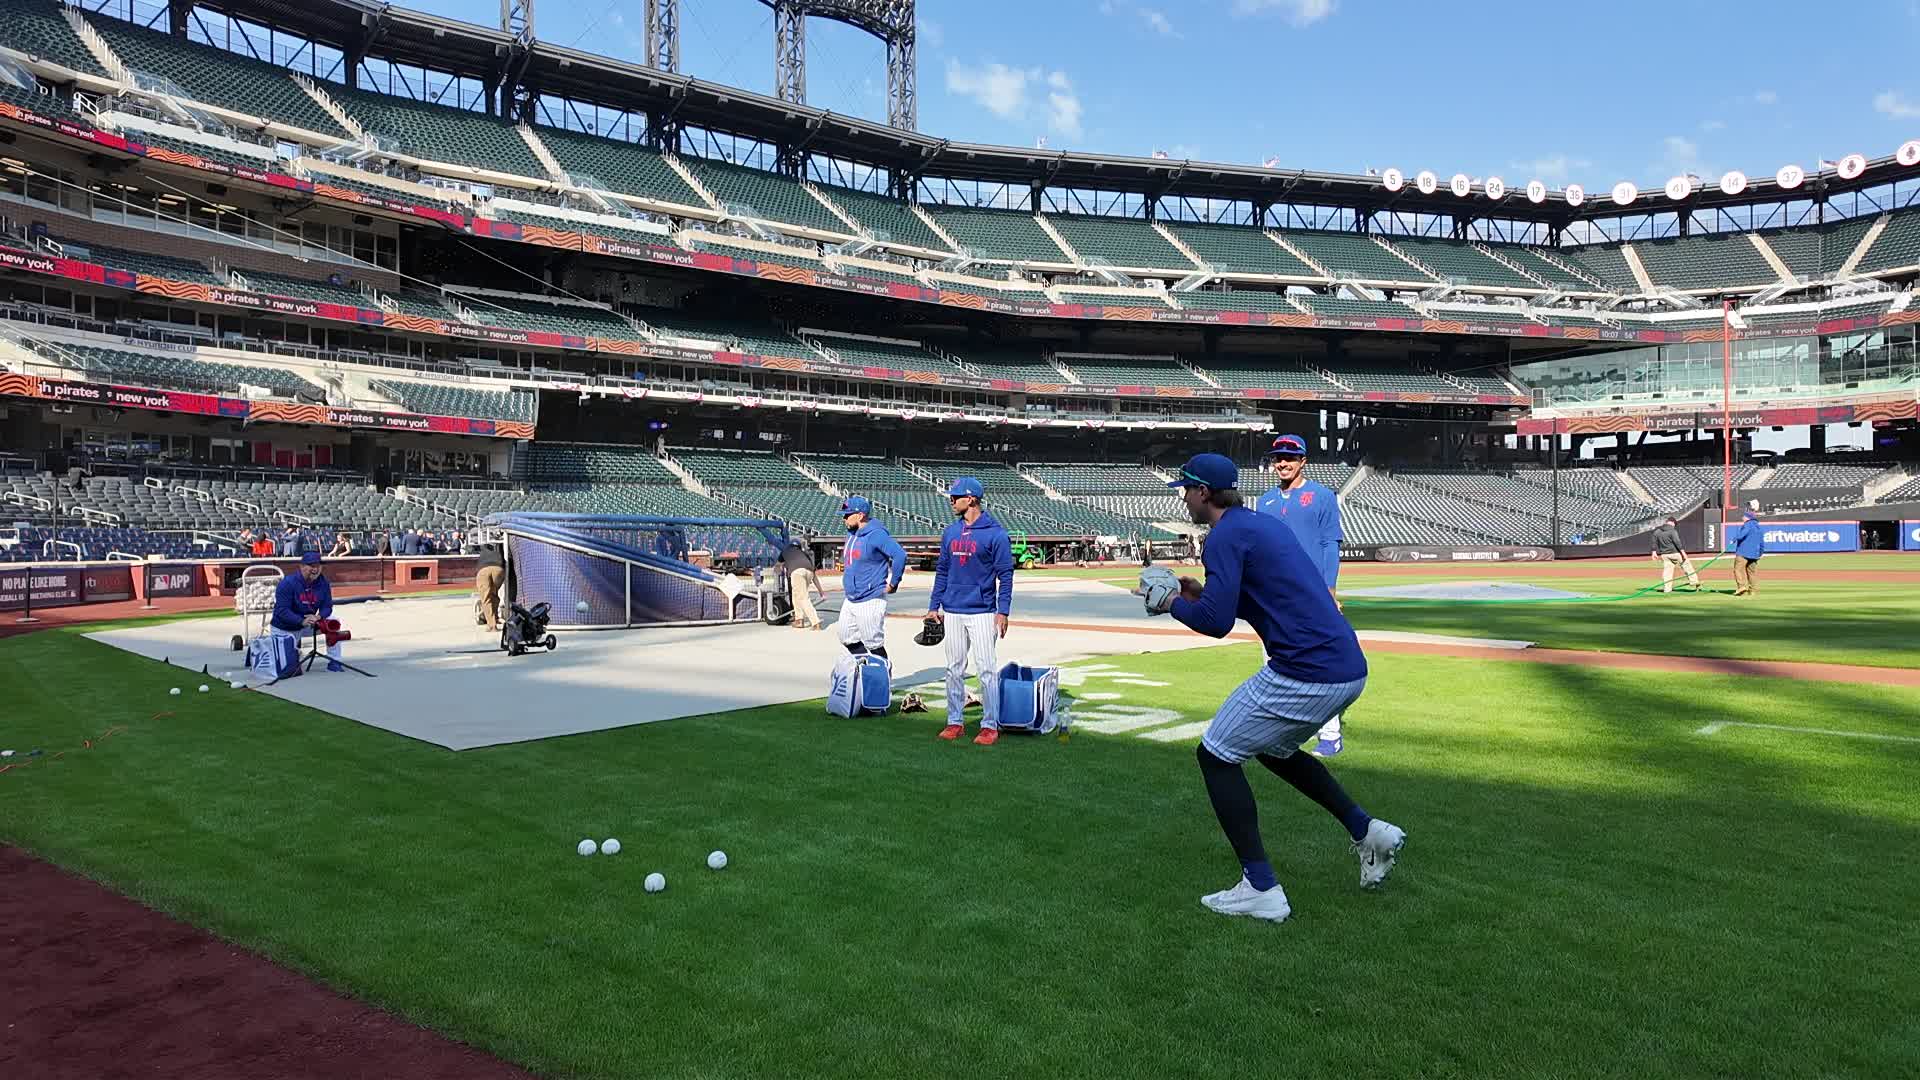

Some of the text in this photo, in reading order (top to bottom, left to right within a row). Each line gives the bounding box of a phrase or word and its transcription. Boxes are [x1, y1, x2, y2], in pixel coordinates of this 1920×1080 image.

[25, 114, 51, 126] pirates
[61, 124, 77, 134] new
[78, 129, 95, 139] york
[205, 161, 229, 172] pirates
[253, 173, 267, 181] york
[1390, 175, 1395, 185] 5
[1422, 177, 1431, 187] 18
[1783, 172, 1797, 182] 37
[1456, 180, 1464, 190] 16
[1489, 183, 1500, 193] 24
[1532, 187, 1540, 196] 17
[363, 197, 382, 205] pirates
[608, 243, 641, 255] pirates
[653, 250, 672, 260] new
[674, 254, 693, 264] york
[0, 252, 54, 271] new york
[822, 277, 847, 287] pirates
[224, 293, 260, 305] pirates
[273, 300, 294, 310] new
[295, 303, 317, 314] york
[991, 301, 1012, 310] pirates
[1319, 318, 1341, 327] pirates
[451, 326, 479, 336] pirates
[490, 330, 507, 339] new
[509, 332, 527, 342] york
[1745, 328, 1771, 337] pirates
[1800, 327, 1817, 335] york
[649, 348, 673, 357] pirates
[811, 364, 831, 372] pirates
[55, 384, 100, 398] pirates
[116, 392, 142, 402] new
[143, 395, 170, 407] york
[339, 413, 374, 424] pirates
[387, 417, 408, 426] new
[408, 419, 429, 428] york
[1656, 417, 1695, 427] pirates
[1710, 416, 1735, 424] new
[1737, 415, 1763, 425] york
[1763, 530, 1826, 543] artwater
[2, 578, 13, 590] NO
[14, 576, 34, 589] PLAE
[170, 574, 190, 589] APP
